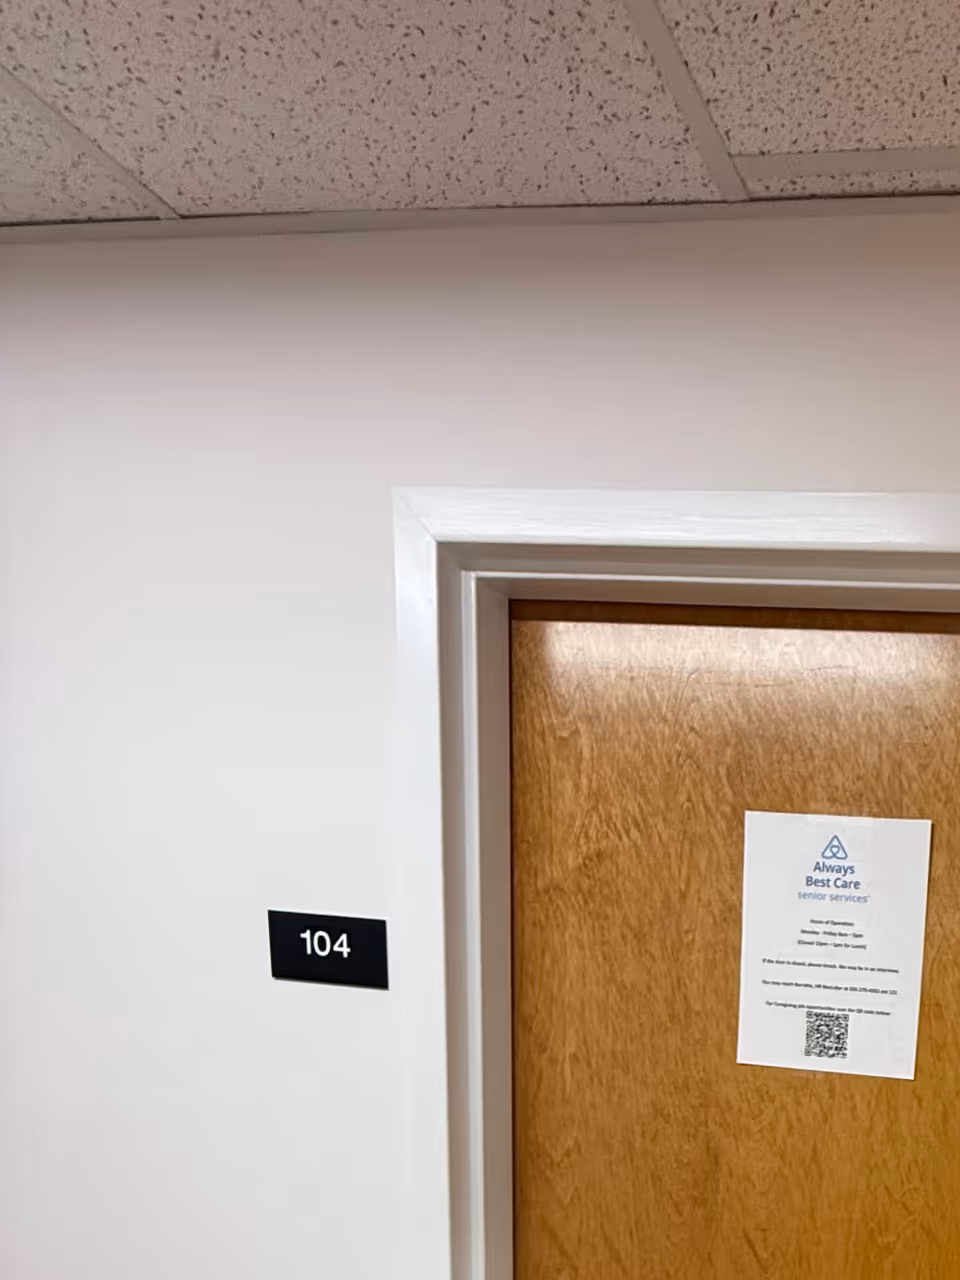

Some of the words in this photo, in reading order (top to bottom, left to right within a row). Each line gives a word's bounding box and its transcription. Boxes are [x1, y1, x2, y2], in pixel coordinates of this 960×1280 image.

[813, 861, 855, 877] Always
[806, 876, 831, 888] Best
[834, 877, 861, 889] Care
[798, 891, 828, 900] senior
[300, 929, 351, 958] 104
